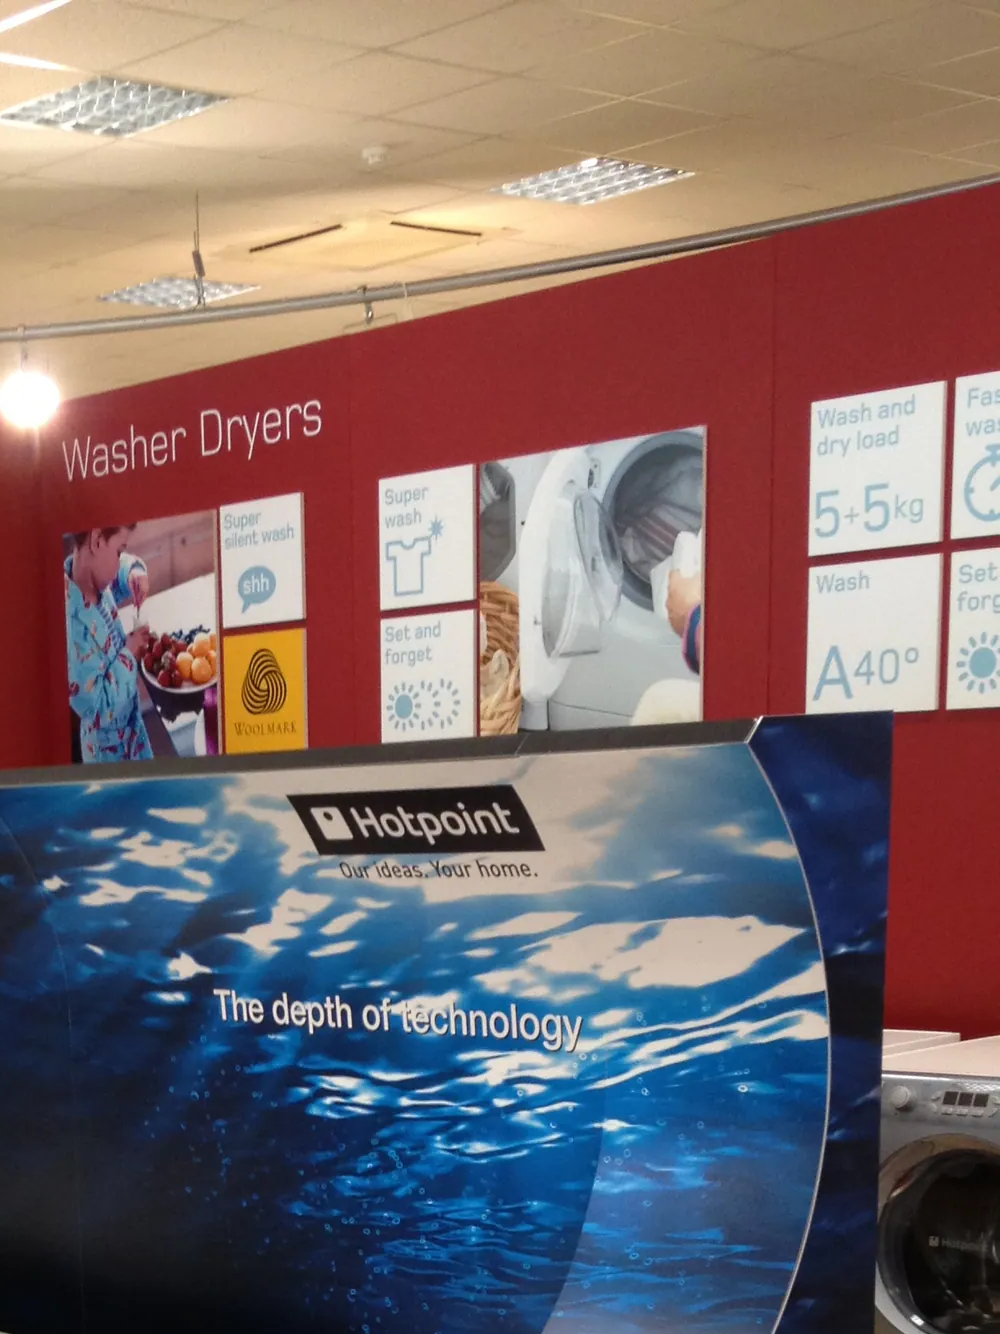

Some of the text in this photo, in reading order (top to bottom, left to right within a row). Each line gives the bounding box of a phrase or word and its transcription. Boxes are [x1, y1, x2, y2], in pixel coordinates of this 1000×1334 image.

[816, 395, 916, 428] Wash and
[62, 399, 323, 482] Washer Dryers
[816, 426, 900, 458] dry load
[384, 485, 429, 507] Super
[224, 511, 262, 531] Super
[384, 509, 423, 528] wash
[225, 524, 295, 550] silent wash
[815, 571, 870, 594] Wash
[958, 561, 998, 584] Set
[242, 573, 270, 596] shh
[385, 622, 442, 645] Set and
[385, 646, 432, 667] forget
[350, 801, 519, 845] Hotpoint
[339, 858, 539, 879] Our ideas. Your home.
[213, 989, 583, 1053] The depth of technology
